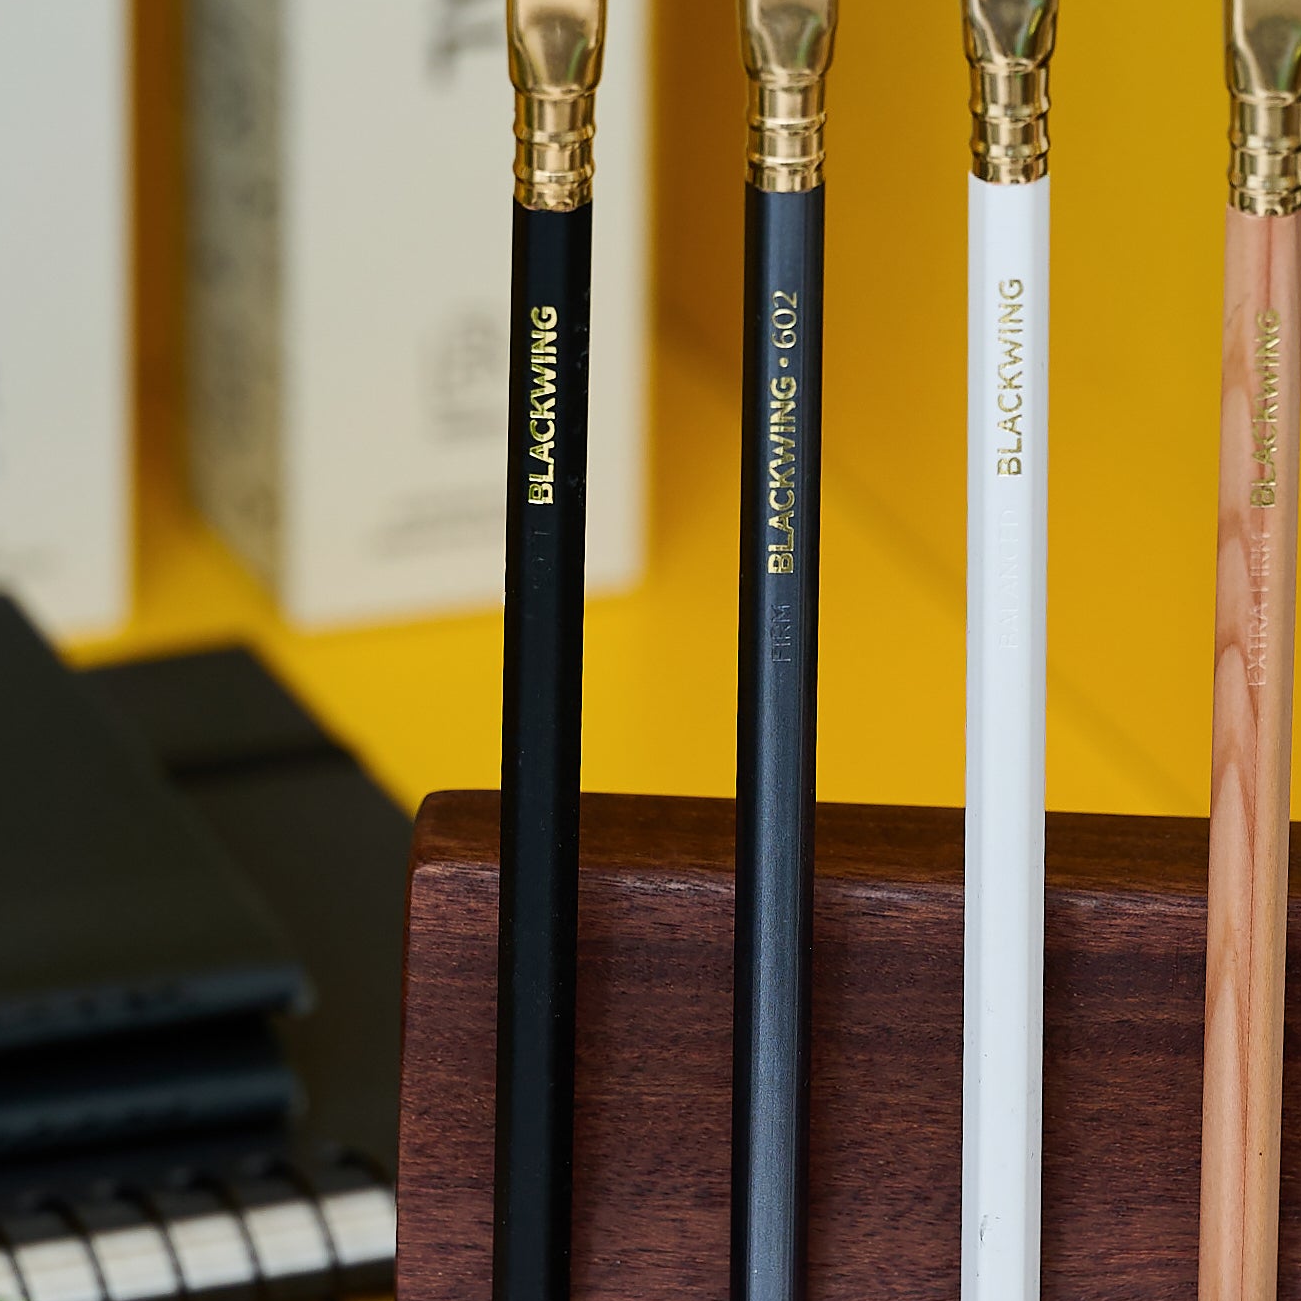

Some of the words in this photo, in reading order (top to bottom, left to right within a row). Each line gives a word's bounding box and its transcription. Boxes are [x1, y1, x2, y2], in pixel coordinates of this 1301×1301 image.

[528, 305, 558, 505] BLACKWING
[771, 290, 798, 349] 602
[997, 277, 1024, 477] BLACKWING
[1250, 307, 1282, 509] BLACKWING
[768, 375, 797, 575] BLACKWING
[770, 604, 793, 663] FIRM
